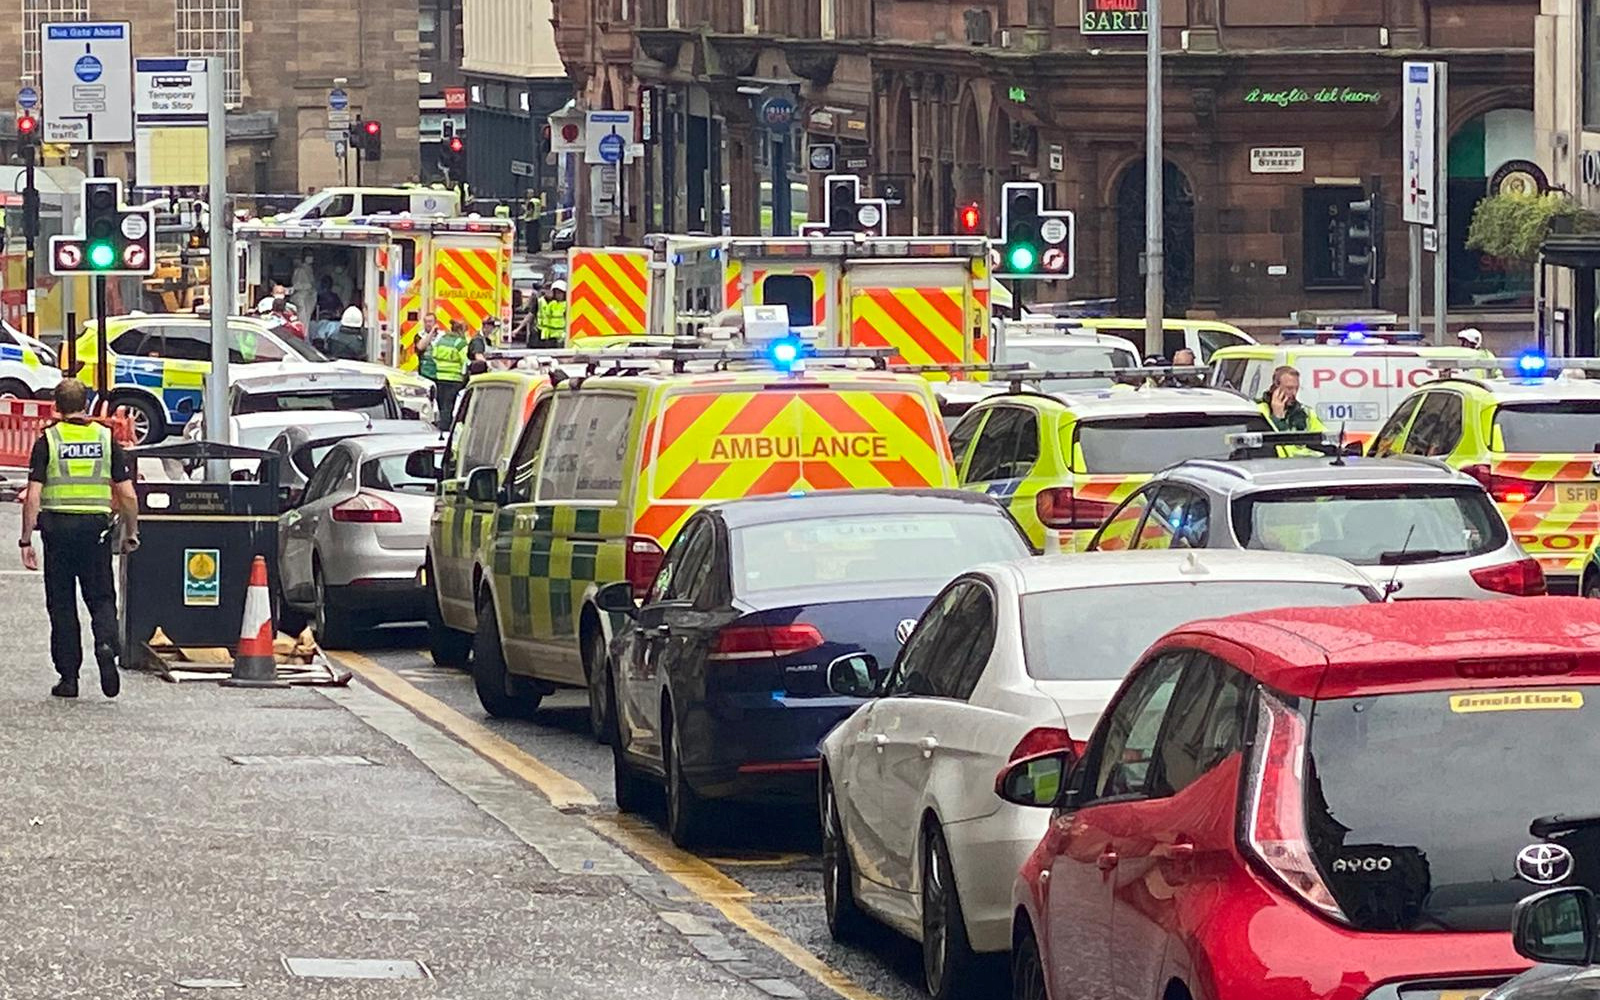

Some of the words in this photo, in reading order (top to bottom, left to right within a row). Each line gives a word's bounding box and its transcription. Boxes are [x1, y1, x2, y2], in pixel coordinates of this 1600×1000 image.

[1084, 11, 1149, 30] SARTI
[50, 28, 68, 37] Bus
[70, 28, 91, 37] Gate
[148, 90, 195, 102] Temporary
[152, 101, 169, 110] Bus
[171, 101, 193, 112] Stop
[47, 122, 83, 131] Through
[51, 131, 79, 139] traffic
[1258, 158, 1297, 166] STREET
[1312, 368, 1458, 389] POLIC
[1327, 405, 1353, 419] 101
[60, 443, 102, 458] POLICE
[710, 435, 888, 460] AMBULANCE
[1457, 696, 1522, 707] Arnold
[1524, 694, 1573, 704] Clark
[1331, 856, 1392, 872] AYGO
